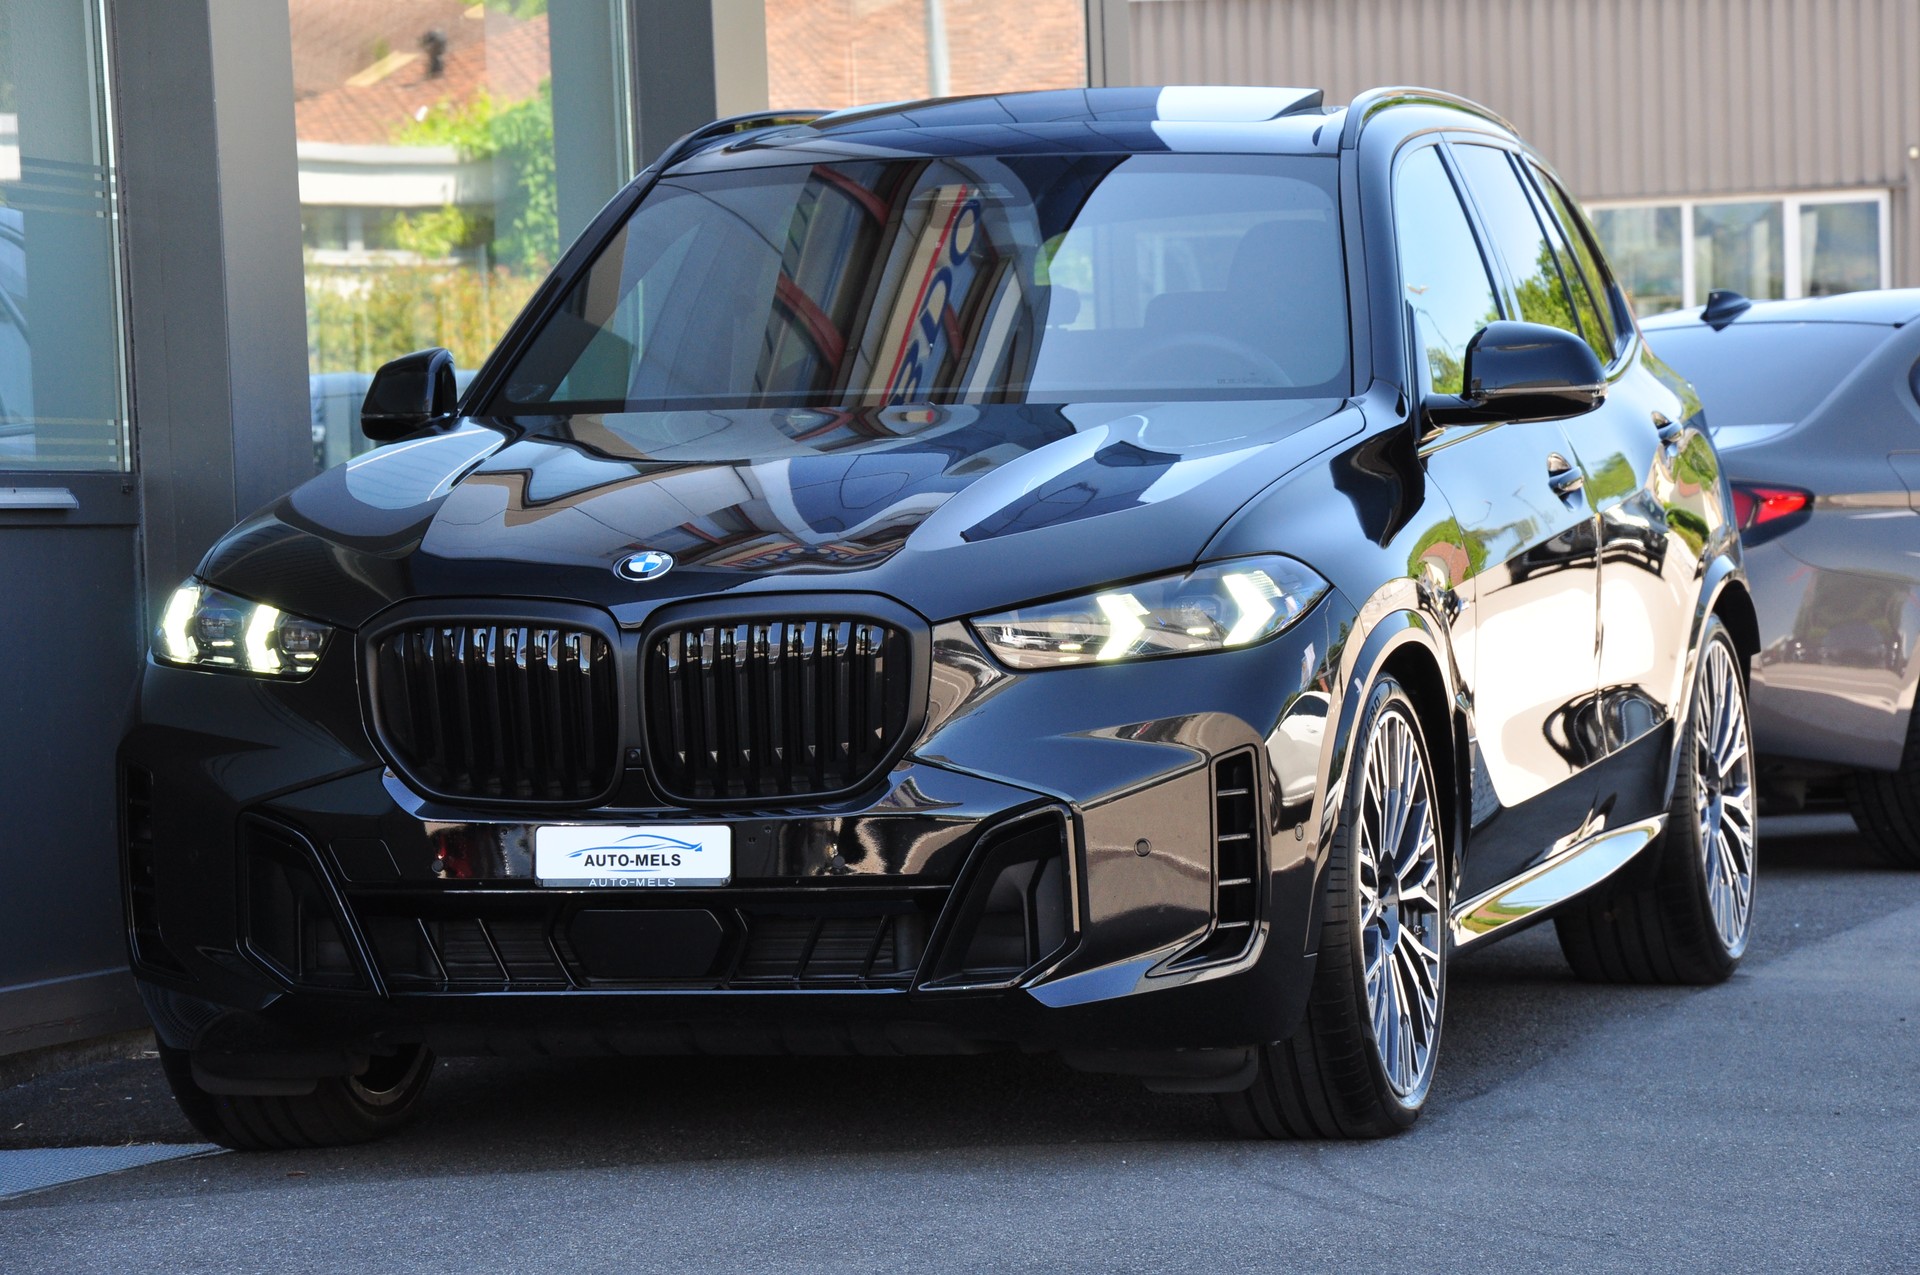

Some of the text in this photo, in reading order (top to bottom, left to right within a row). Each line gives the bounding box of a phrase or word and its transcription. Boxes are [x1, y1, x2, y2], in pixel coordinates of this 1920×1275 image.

[1363, 695, 1381, 748] ZERO
[584, 854, 681, 867] AUTO-MELS
[588, 877, 677, 887] AUTO-MELS
